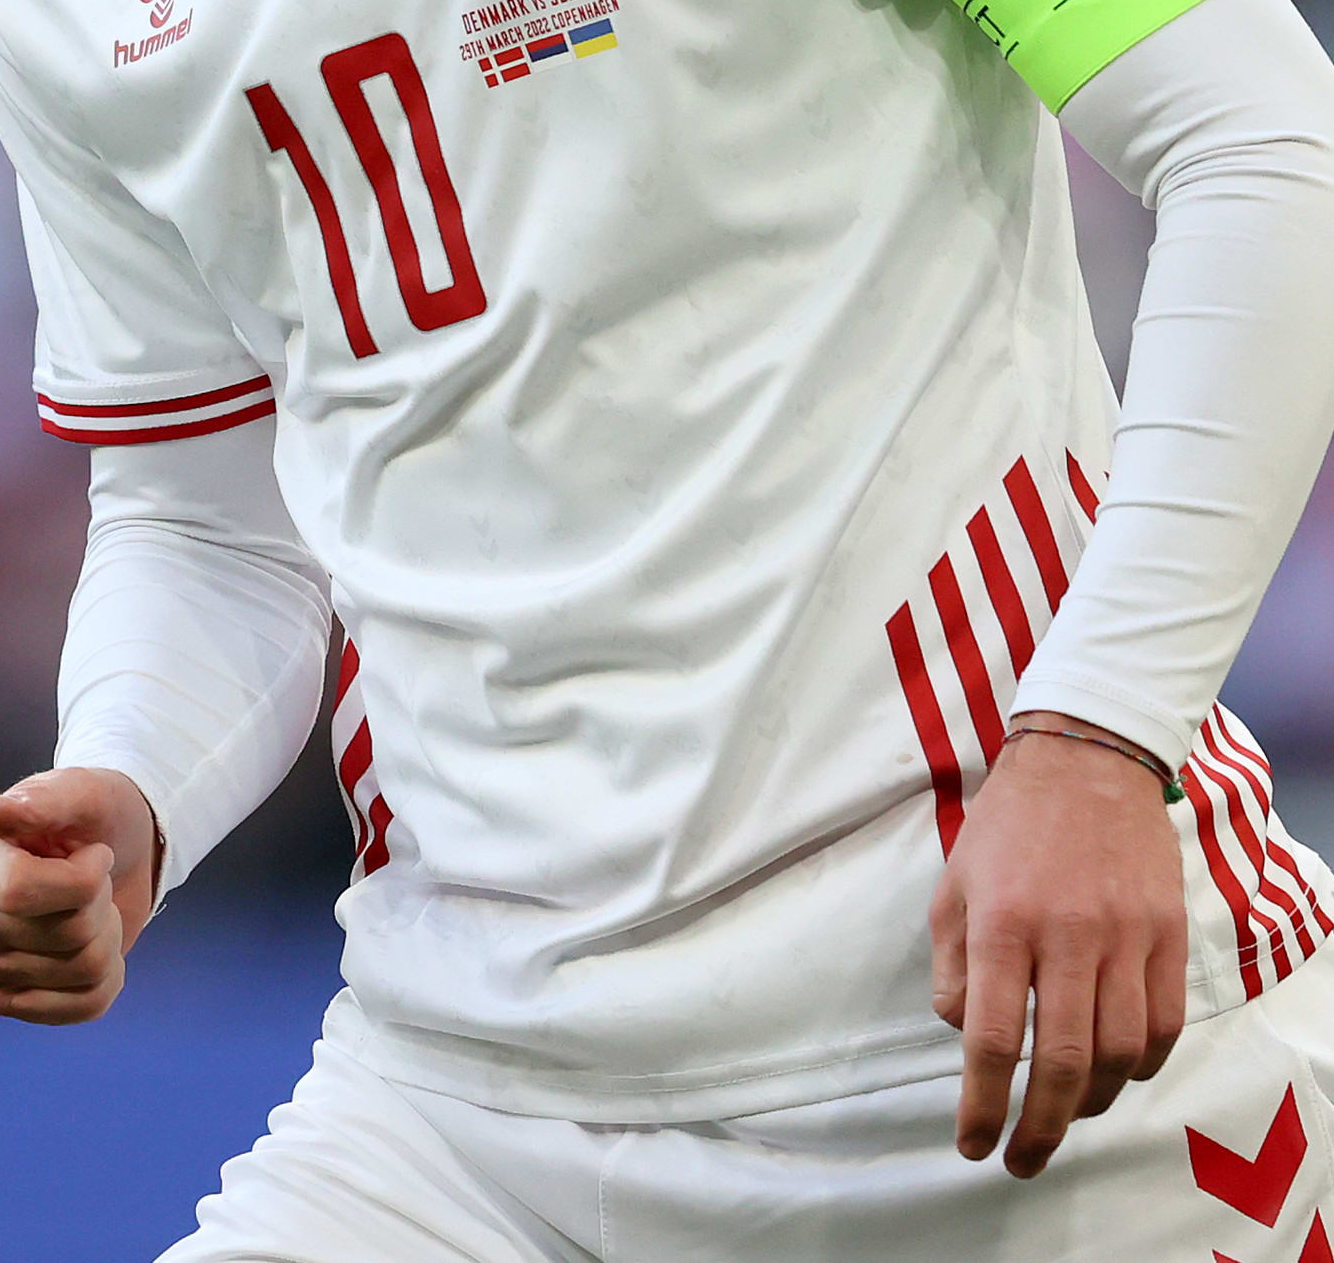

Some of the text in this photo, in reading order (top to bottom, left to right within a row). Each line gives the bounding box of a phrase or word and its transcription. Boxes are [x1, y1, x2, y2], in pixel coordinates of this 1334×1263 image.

[114, 7, 193, 68] hummel
[459, 39, 485, 61] 29TH
[485, 26, 525, 51] MARCH
[524, 17, 551, 38] 2022
[244, 32, 488, 359] 10
